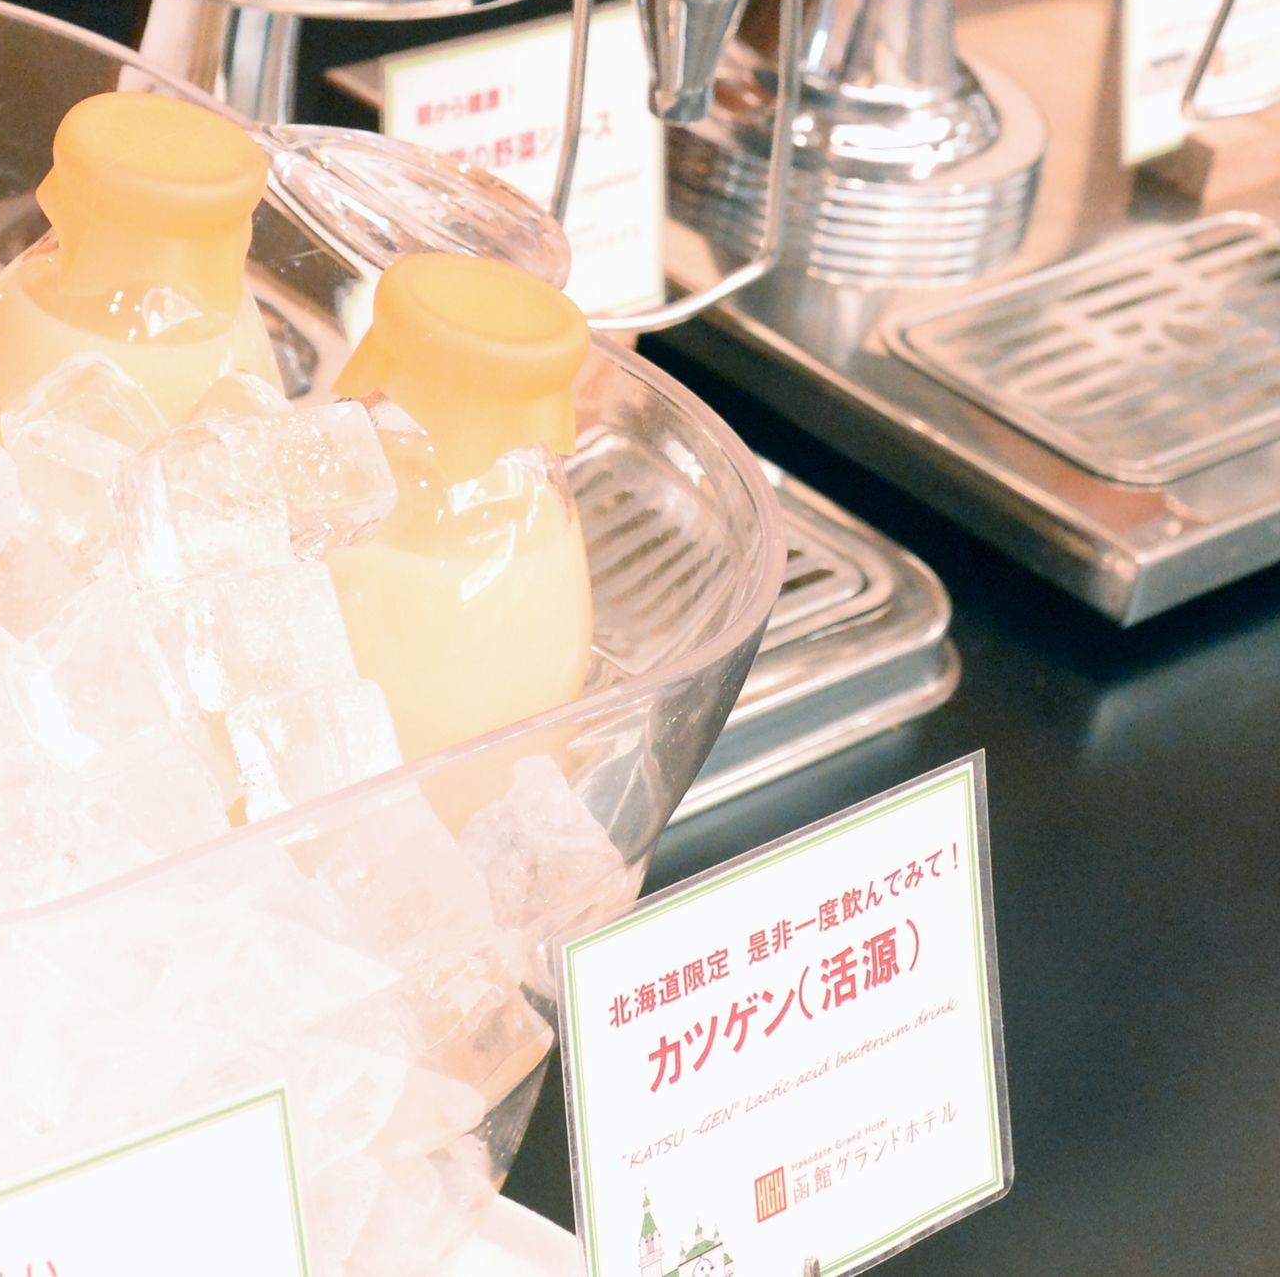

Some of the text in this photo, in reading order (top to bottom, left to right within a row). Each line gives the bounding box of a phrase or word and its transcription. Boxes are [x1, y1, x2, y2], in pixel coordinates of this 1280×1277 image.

[609, 842, 959, 1028] 北海道限定 是非一度飲んでみて！
[648, 919, 920, 1093] カツゲン（活源）
[745, 1078, 793, 1113] Lactic
[796, 1056, 830, 1086] acid
[835, 1023, 911, 1070] bacterium
[914, 996, 959, 1028] drink
[791, 1117, 888, 1172] Hakodate Grand Hotel
[793, 1101, 958, 1204] 函館グランドホテル
